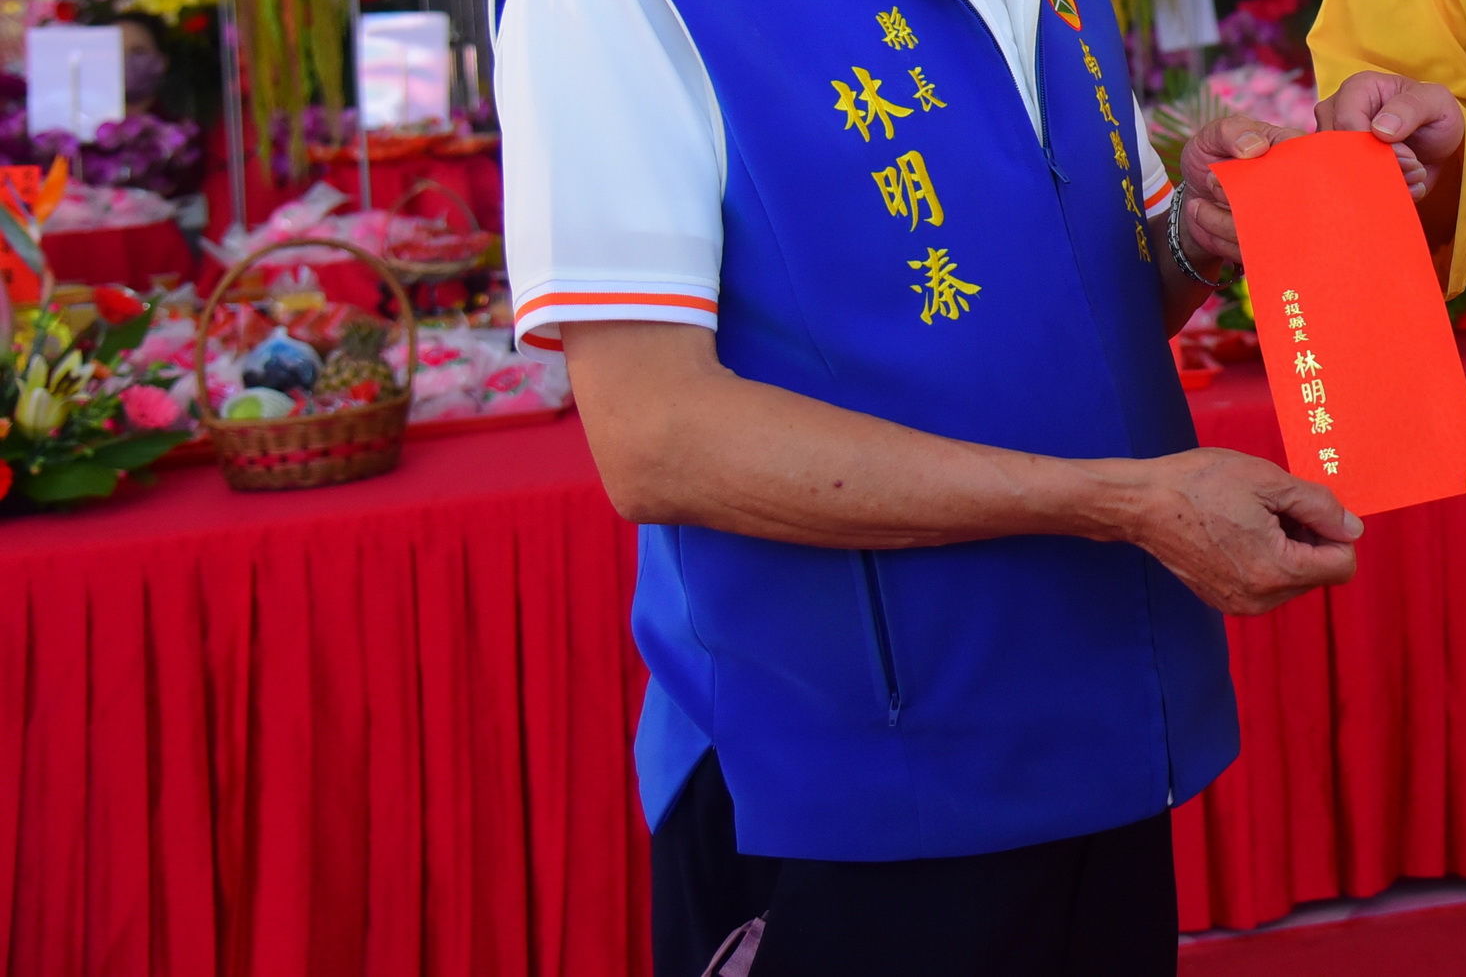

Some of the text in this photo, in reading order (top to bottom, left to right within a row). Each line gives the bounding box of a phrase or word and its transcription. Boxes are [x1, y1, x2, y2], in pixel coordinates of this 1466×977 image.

[875, 6, 948, 113] 縣長
[1078, 37, 1152, 263] 南投縣政府
[830, 65, 983, 326] 林明溱
[1281, 289, 1340, 476] 南投縣長 林明溱 敬賀
